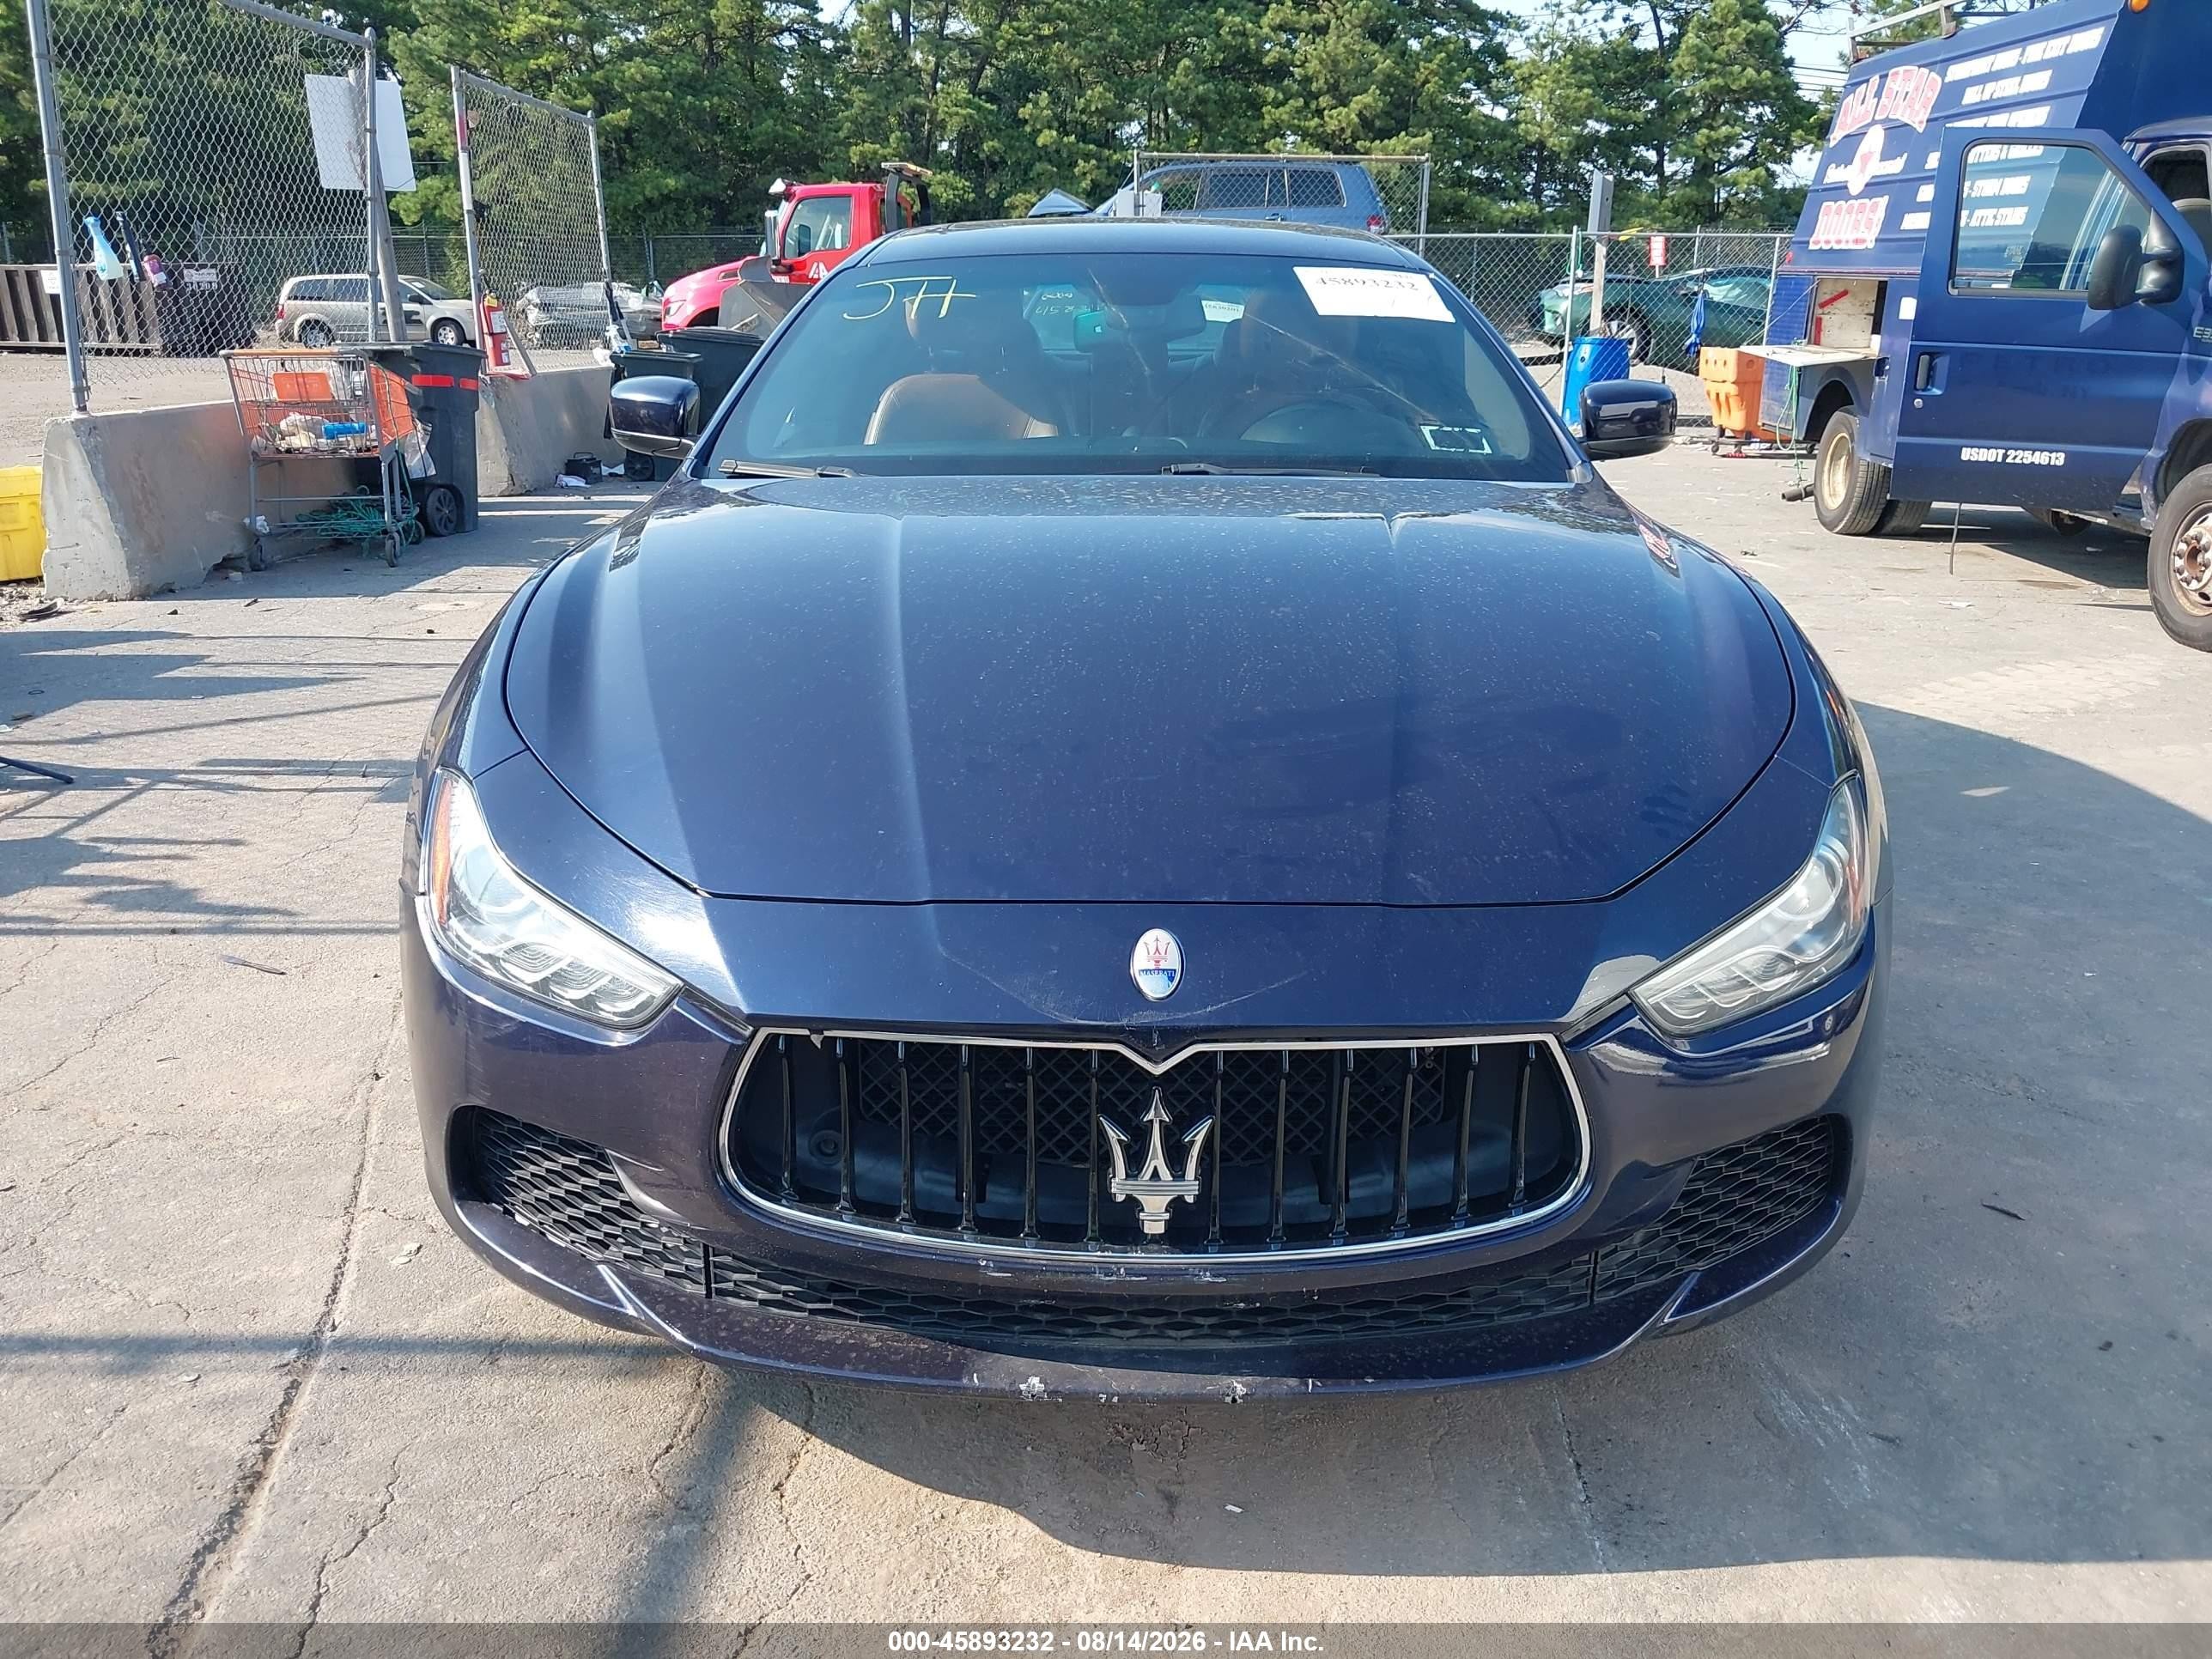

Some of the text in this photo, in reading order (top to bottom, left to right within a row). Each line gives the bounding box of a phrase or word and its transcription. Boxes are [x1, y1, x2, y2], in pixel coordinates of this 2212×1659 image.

[1830, 65, 1942, 148] ALL STAR
[2192, 326, 2212, 339] E3
[1960, 447, 2066, 467] USDOT 2254613
